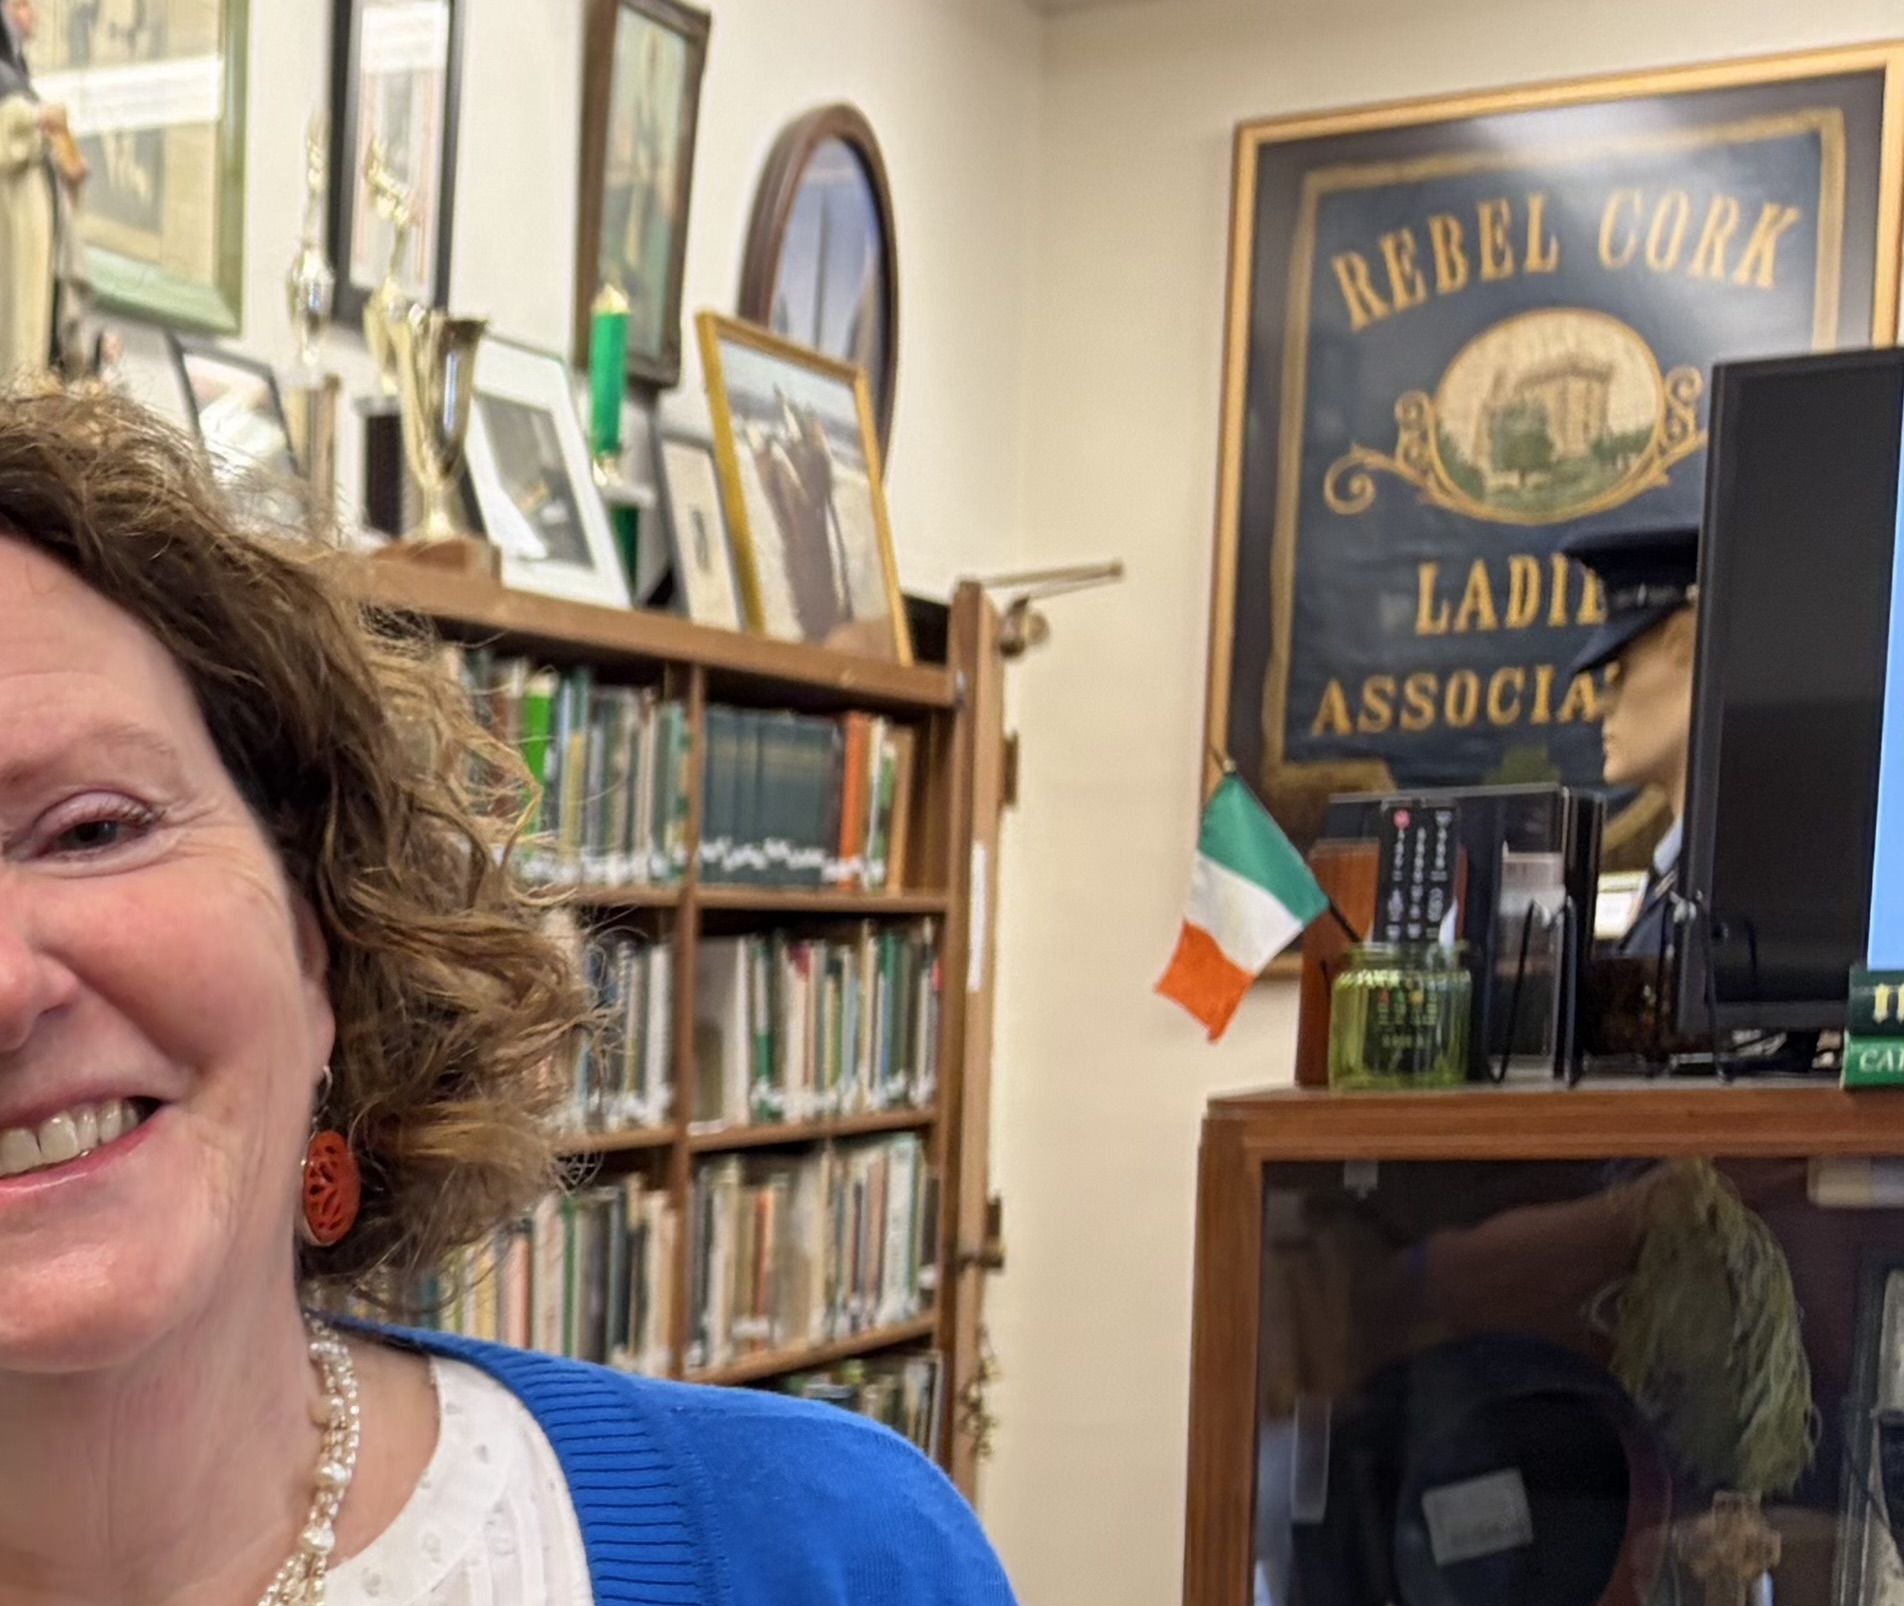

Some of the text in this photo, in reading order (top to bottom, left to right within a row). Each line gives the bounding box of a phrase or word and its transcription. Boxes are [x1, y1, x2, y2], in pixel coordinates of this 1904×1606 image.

[1332, 187, 1800, 331] REBEL CORK
[1312, 662, 1621, 736] ASSOCIA
